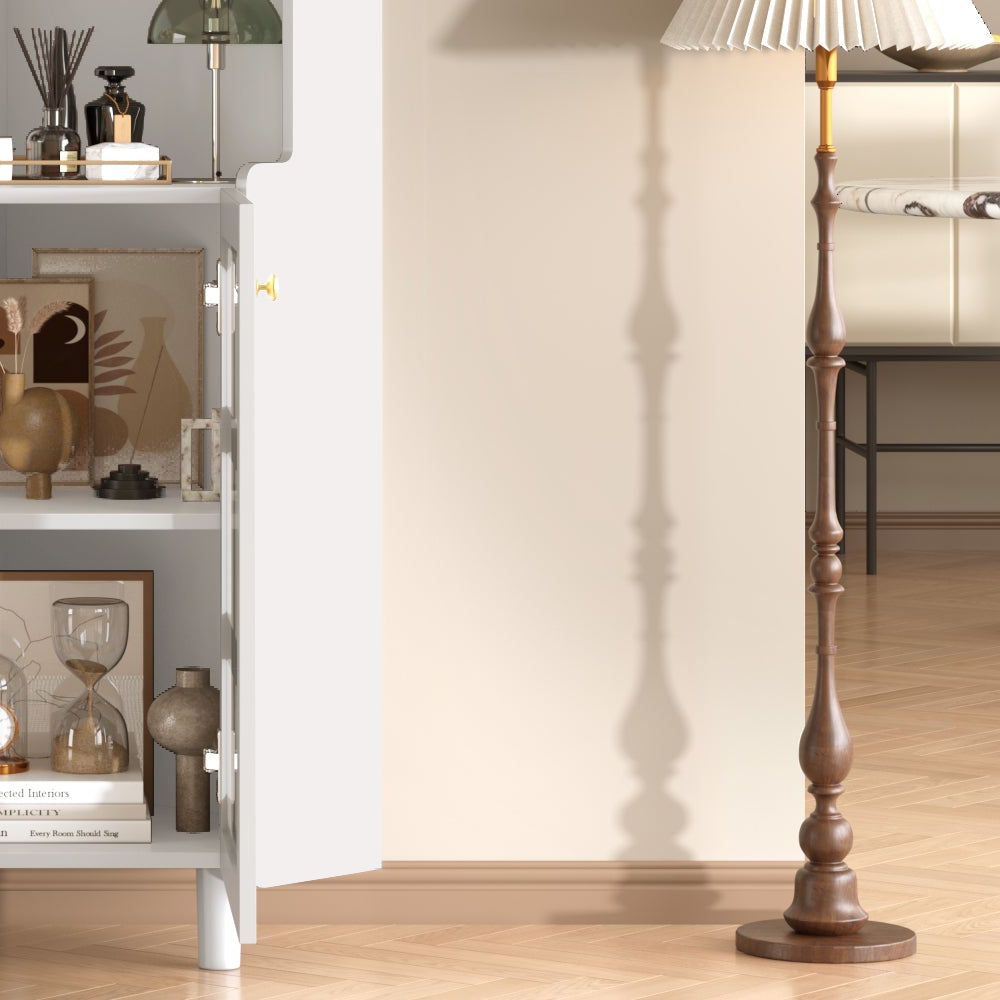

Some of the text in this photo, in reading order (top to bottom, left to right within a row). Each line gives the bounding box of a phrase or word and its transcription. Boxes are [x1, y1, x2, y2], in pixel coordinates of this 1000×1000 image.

[27, 788, 70, 798] Interiors
[30, 830, 51, 838] Every
[76, 829, 101, 837] Should
[103, 830, 119, 838] Sing
